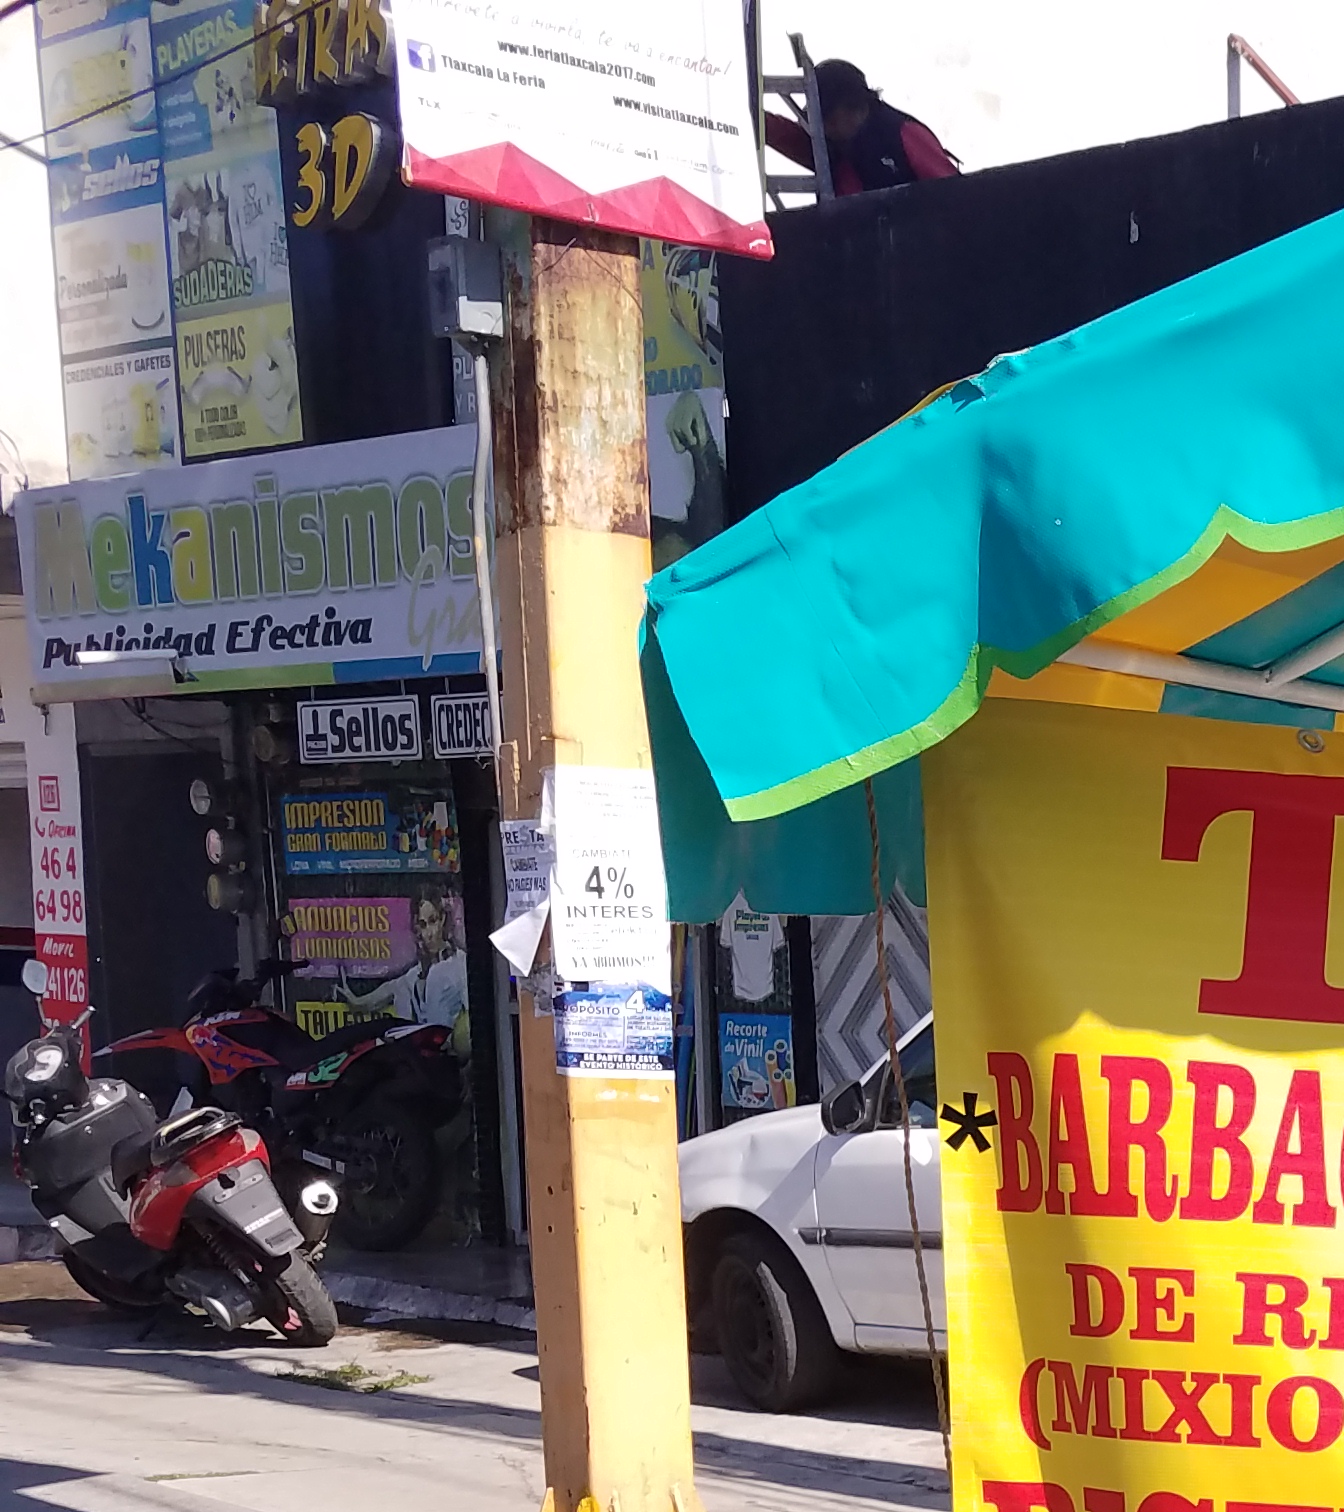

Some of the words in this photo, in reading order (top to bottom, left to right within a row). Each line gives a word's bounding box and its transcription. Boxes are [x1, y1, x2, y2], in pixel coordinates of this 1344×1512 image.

[157, 8, 240, 77] PLAYERAS
[441, 54, 494, 79] Tlaxcala
[497, 68, 510, 83] La
[513, 71, 546, 89] Feria
[612, 96, 739, 136] www.visitatlaxcala.com
[292, 113, 373, 227] 3D
[173, 257, 253, 309] SUDADERAS
[33, 473, 492, 620] Mekanismos
[227, 605, 373, 655] Efectiva
[329, 707, 415, 754] Sellos
[584, 865, 635, 900] 4%
[566, 905, 654, 919] INTERES
[726, 1020, 768, 1038] Recorte
[735, 1038, 764, 1058] Vinil
[1066, 1262, 1197, 1343] DE
